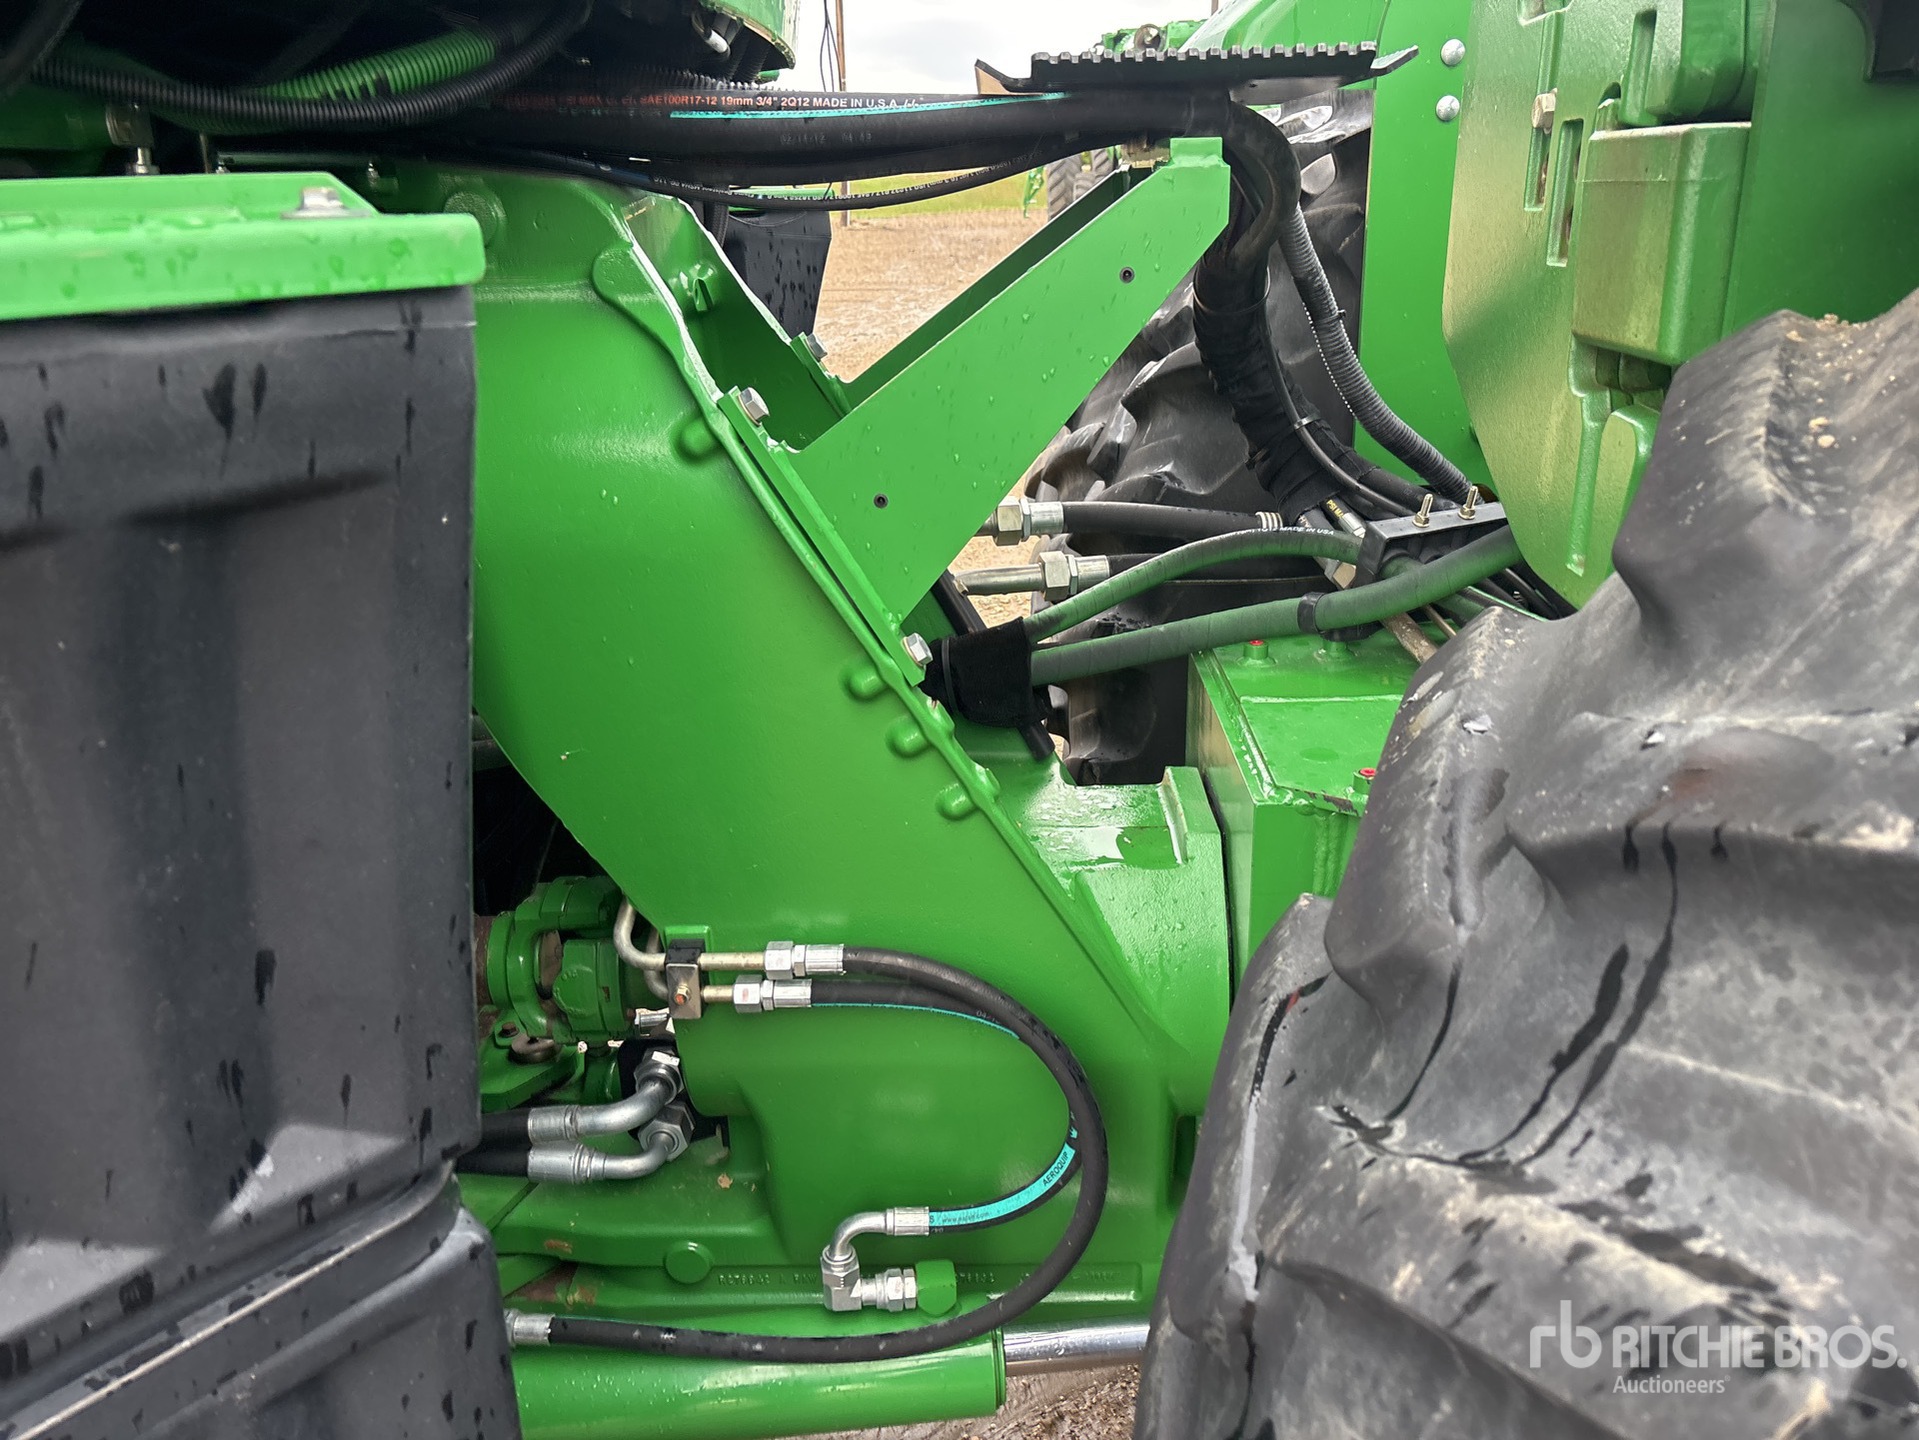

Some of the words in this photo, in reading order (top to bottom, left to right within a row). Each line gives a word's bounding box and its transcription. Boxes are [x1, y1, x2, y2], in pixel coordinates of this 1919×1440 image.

[720, 96, 754, 106] 19mm
[755, 96, 778, 106] 3/4"
[780, 97, 810, 107] 2Q12
[812, 97, 848, 108] MADE
[850, 98, 861, 108] IN
[1325, 498, 1338, 511] PSI
[1280, 525, 1304, 533] MADE
[1317, 528, 1335, 536] USA
[1042, 1151, 1069, 1187] AEROQUIP
